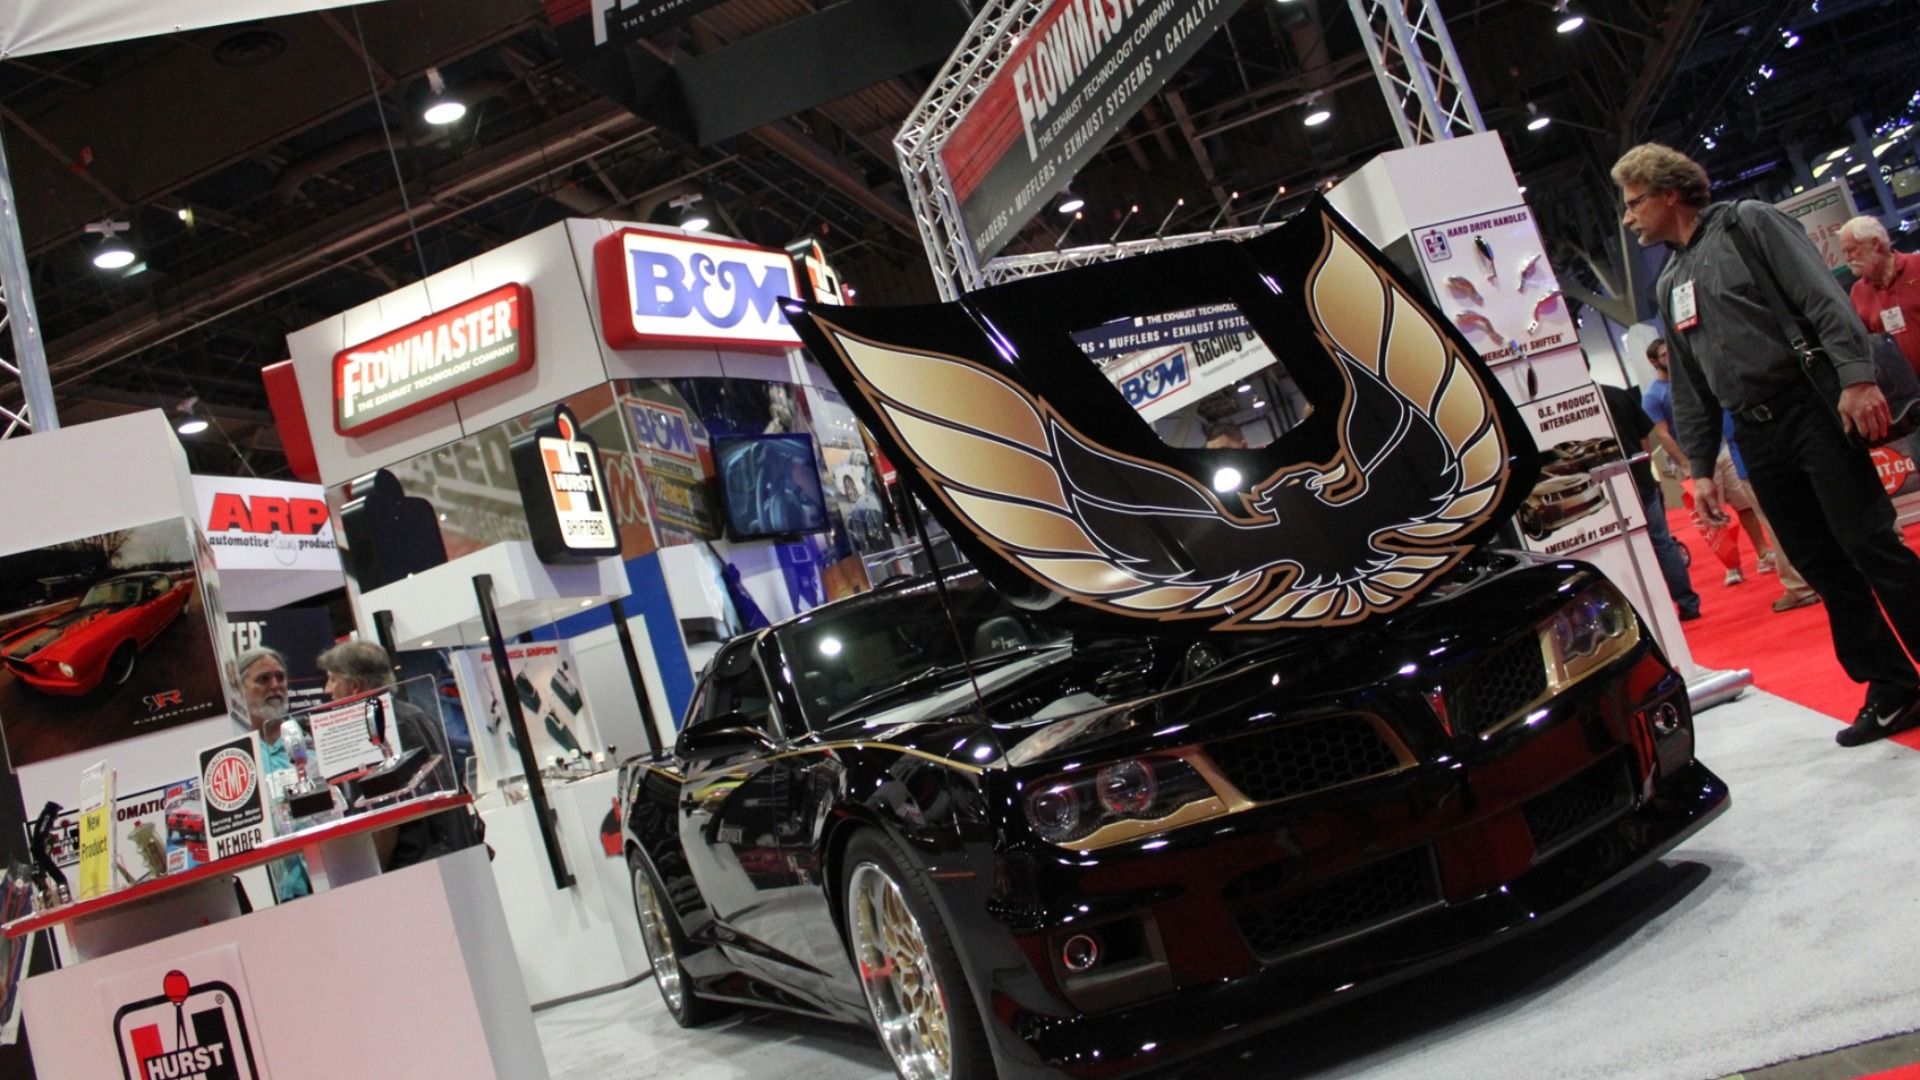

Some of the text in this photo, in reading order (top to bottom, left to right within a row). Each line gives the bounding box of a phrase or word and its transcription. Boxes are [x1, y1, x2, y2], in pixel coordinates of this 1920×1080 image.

[622, 0, 690, 30] THE EXHA
[1013, 0, 1145, 162] FLOWMAS
[1038, 128, 1055, 151] THE
[1051, 94, 1083, 143] EXHAUST
[1082, 35, 1134, 101] TECHNOLOGY
[976, 210, 1008, 253] HEADERS
[1015, 159, 1055, 212] MUFFLERS
[1064, 106, 1104, 160] EXHAUST
[1106, 55, 1153, 116] SYSTEMS
[1447, 211, 1527, 238] HARD DRIVE HANDLES
[630, 249, 791, 329] B&M
[1108, 329, 1160, 350] MUFFLERS
[1172, 322, 1214, 340] EXHAUST
[1217, 314, 1250, 331] SYSTE
[1146, 314, 1163, 326] THE
[1163, 308, 1197, 323] EXHAUST
[343, 300, 513, 419] FLOWMASTER
[1530, 334, 1562, 350] SHIFTER
[357, 343, 516, 413] THE EXHAUST TECHNOLOGY COMPANY
[1121, 354, 1187, 405] B&M
[1537, 391, 1596, 419] O.E. PRODUCT
[1539, 404, 1600, 433] INTERGRATION
[628, 405, 692, 454] B&M
[553, 472, 595, 493] HURST
[208, 492, 330, 535] ARP
[566, 519, 606, 536] SHIFTERS
[209, 535, 270, 548] automotive
[1544, 534, 1587, 555] AMERICA'S
[1599, 517, 1631, 537] SHIFTR
[213, 757, 248, 801] SEMA
[216, 827, 263, 860] MEMBER
[146, 1042, 225, 1080] HURST
